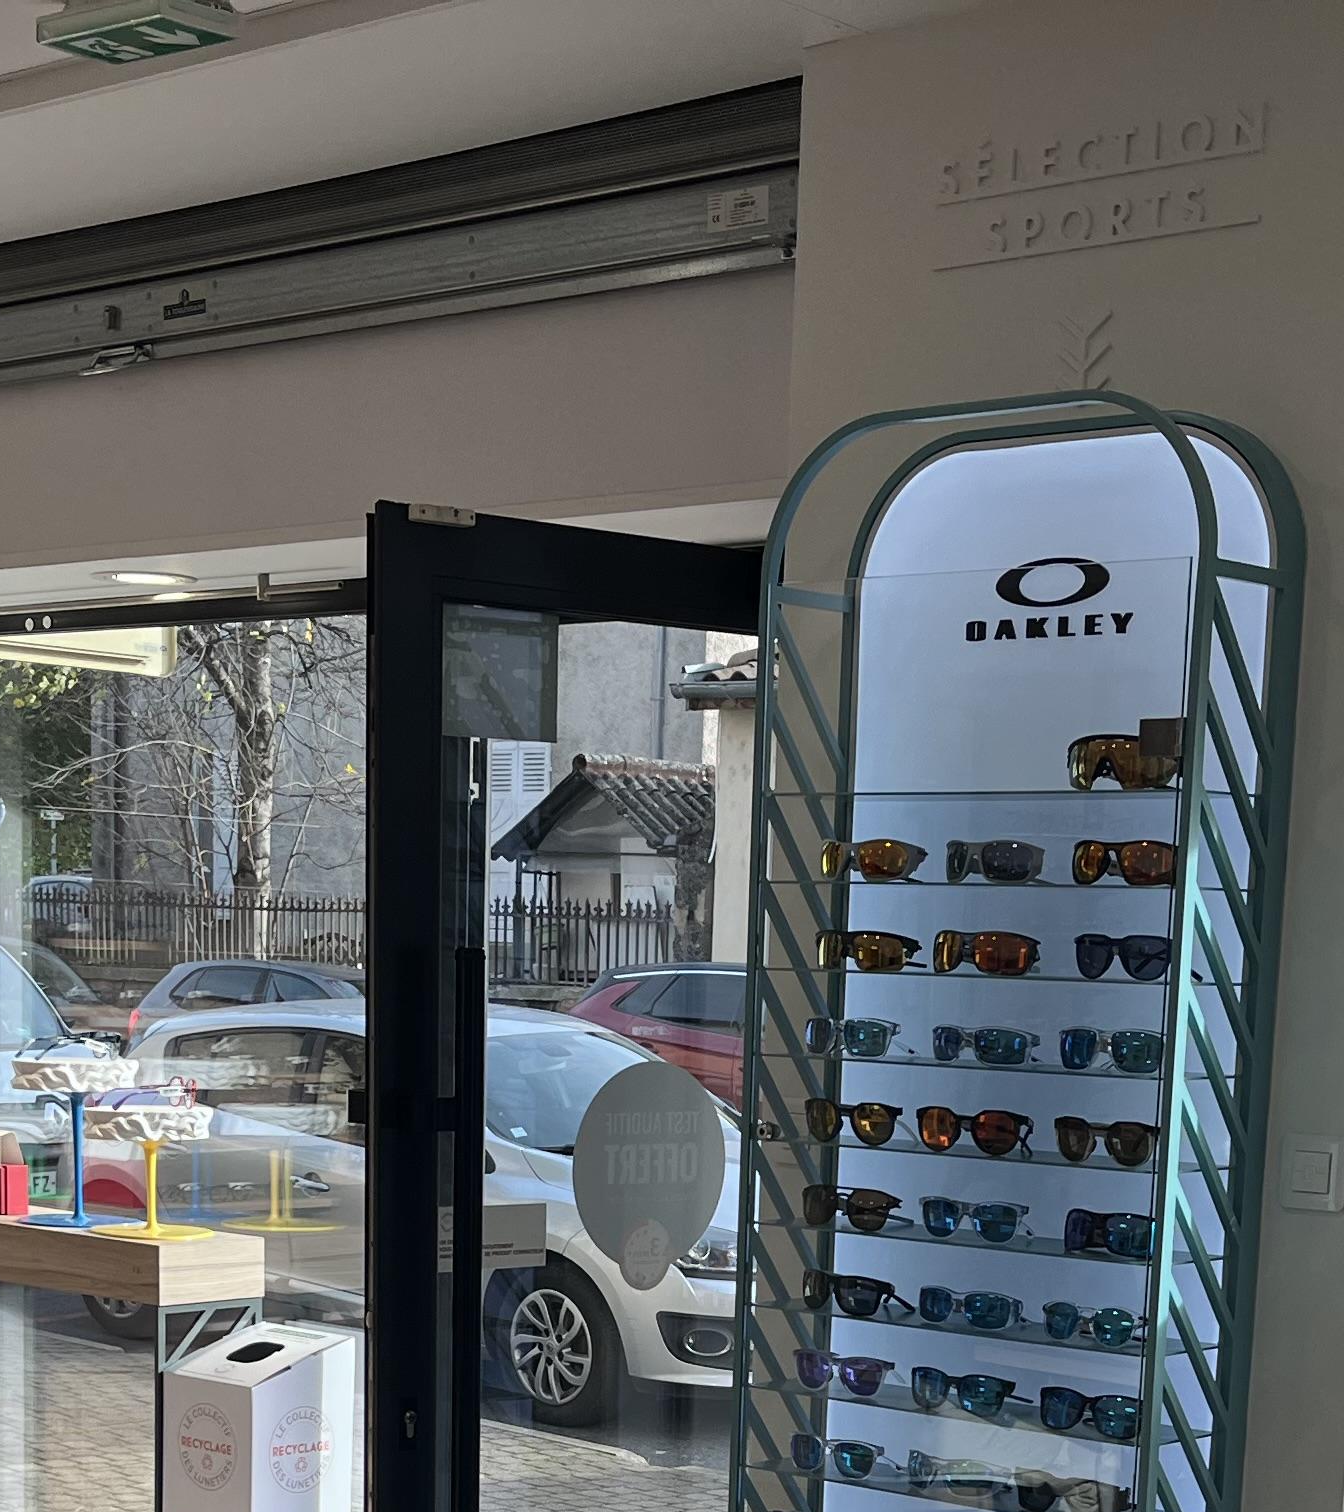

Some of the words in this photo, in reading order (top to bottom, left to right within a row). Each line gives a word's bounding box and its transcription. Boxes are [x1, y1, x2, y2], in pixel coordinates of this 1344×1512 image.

[939, 100, 1270, 195] SÉLECTION
[987, 187, 1206, 253] SPORTS
[965, 611, 1134, 642] OAKLEY
[181, 1435, 232, 1456] RECYCLAGE
[272, 1441, 330, 1457] RECYCLAGE
